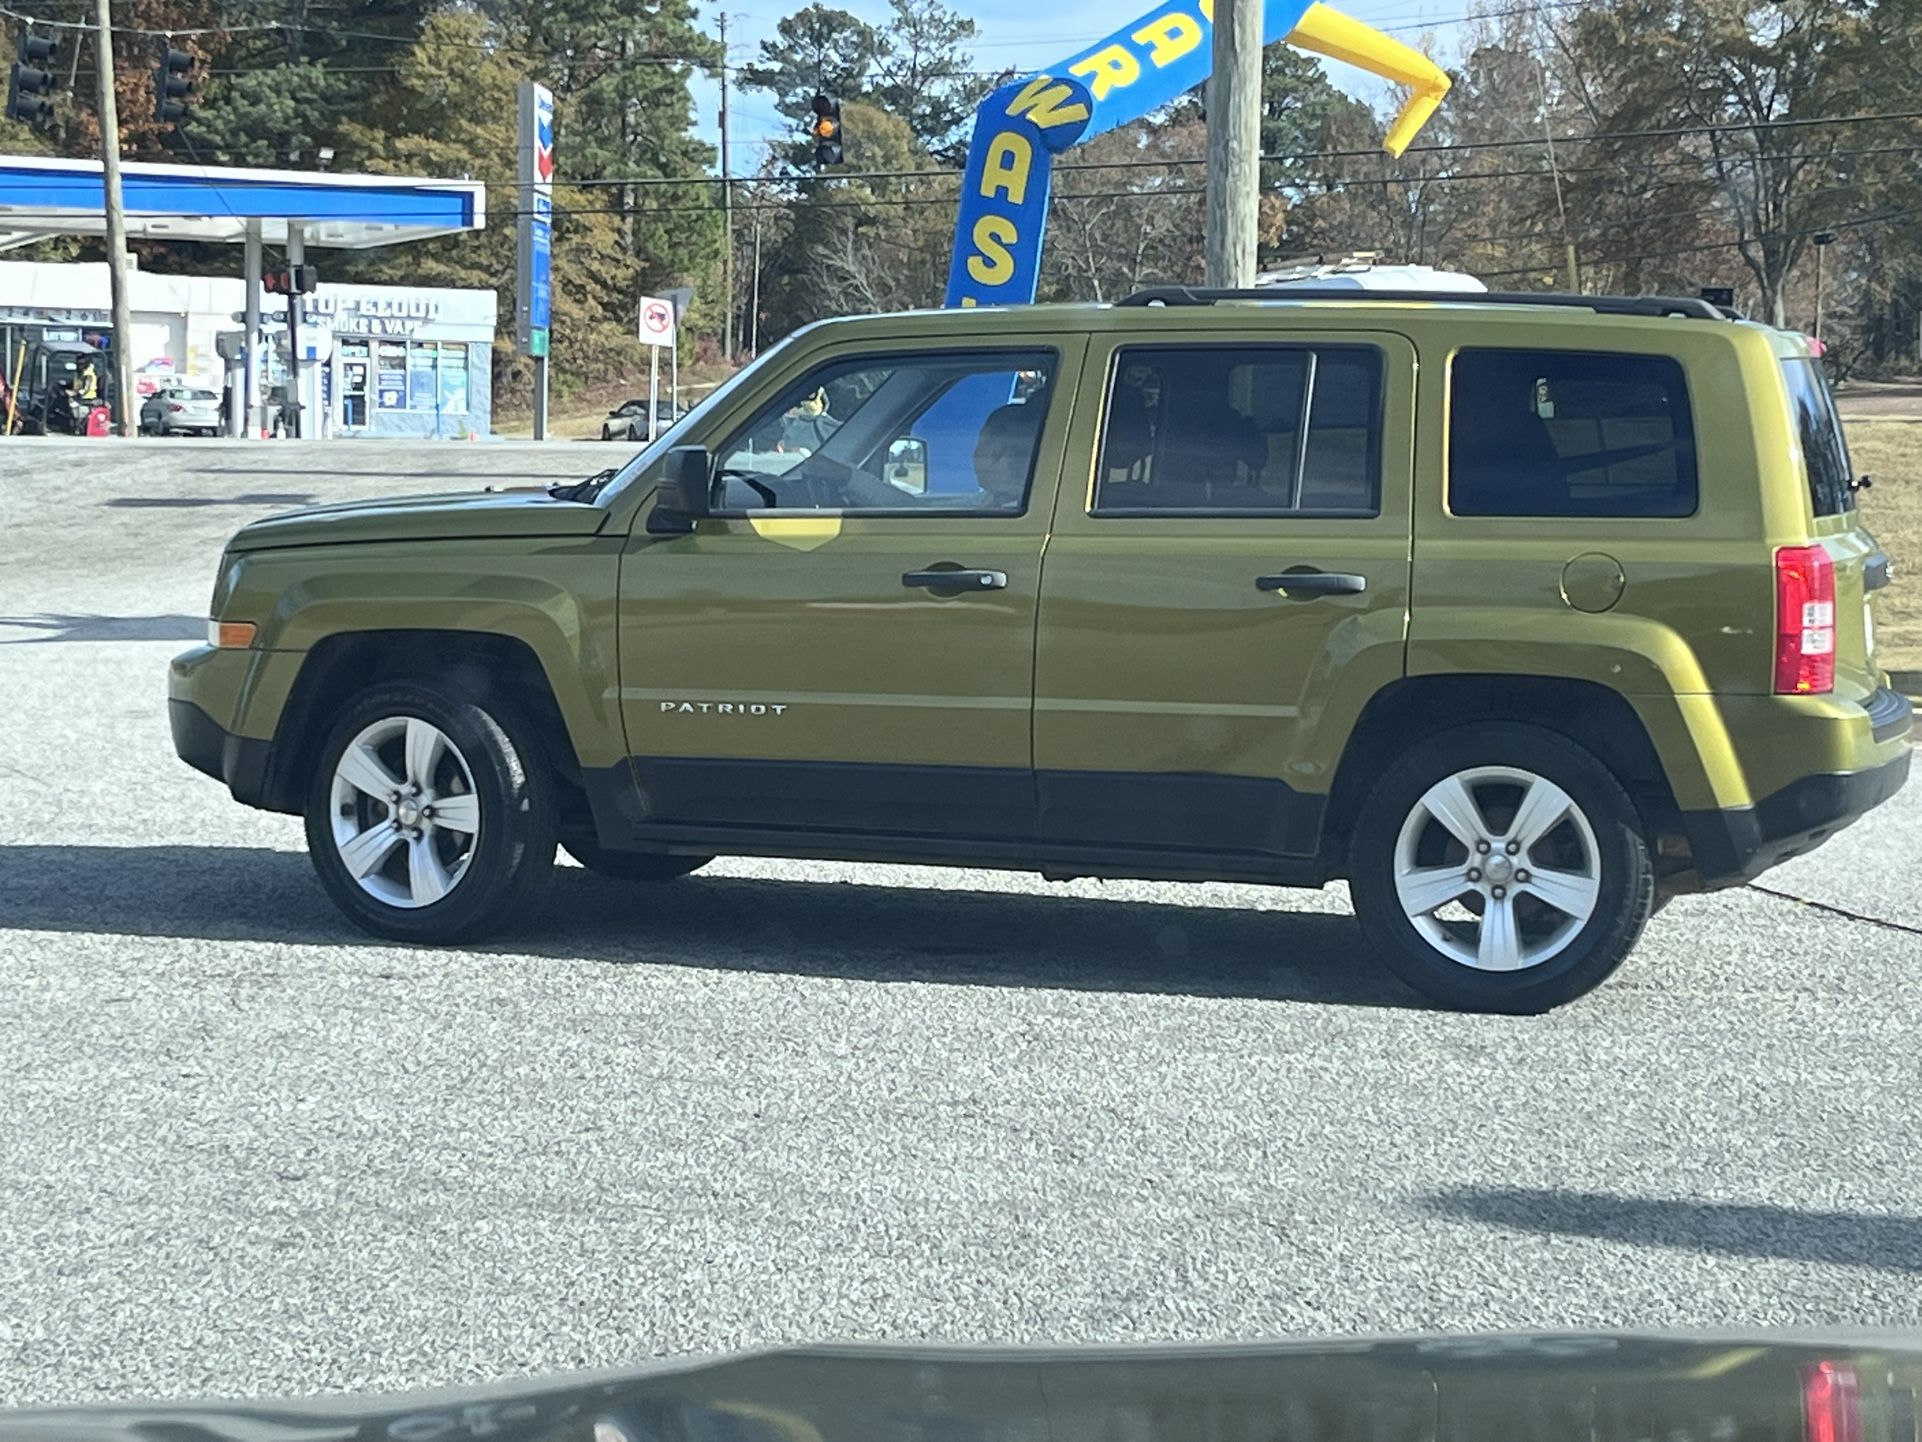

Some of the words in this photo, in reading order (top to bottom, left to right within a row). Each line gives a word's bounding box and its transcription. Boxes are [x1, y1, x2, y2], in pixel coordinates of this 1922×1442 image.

[1069, 0, 1213, 101] AR
[962, 75, 1090, 307] WAS
[317, 314, 368, 333] SMOKE
[660, 701, 787, 716] PATRIOT
